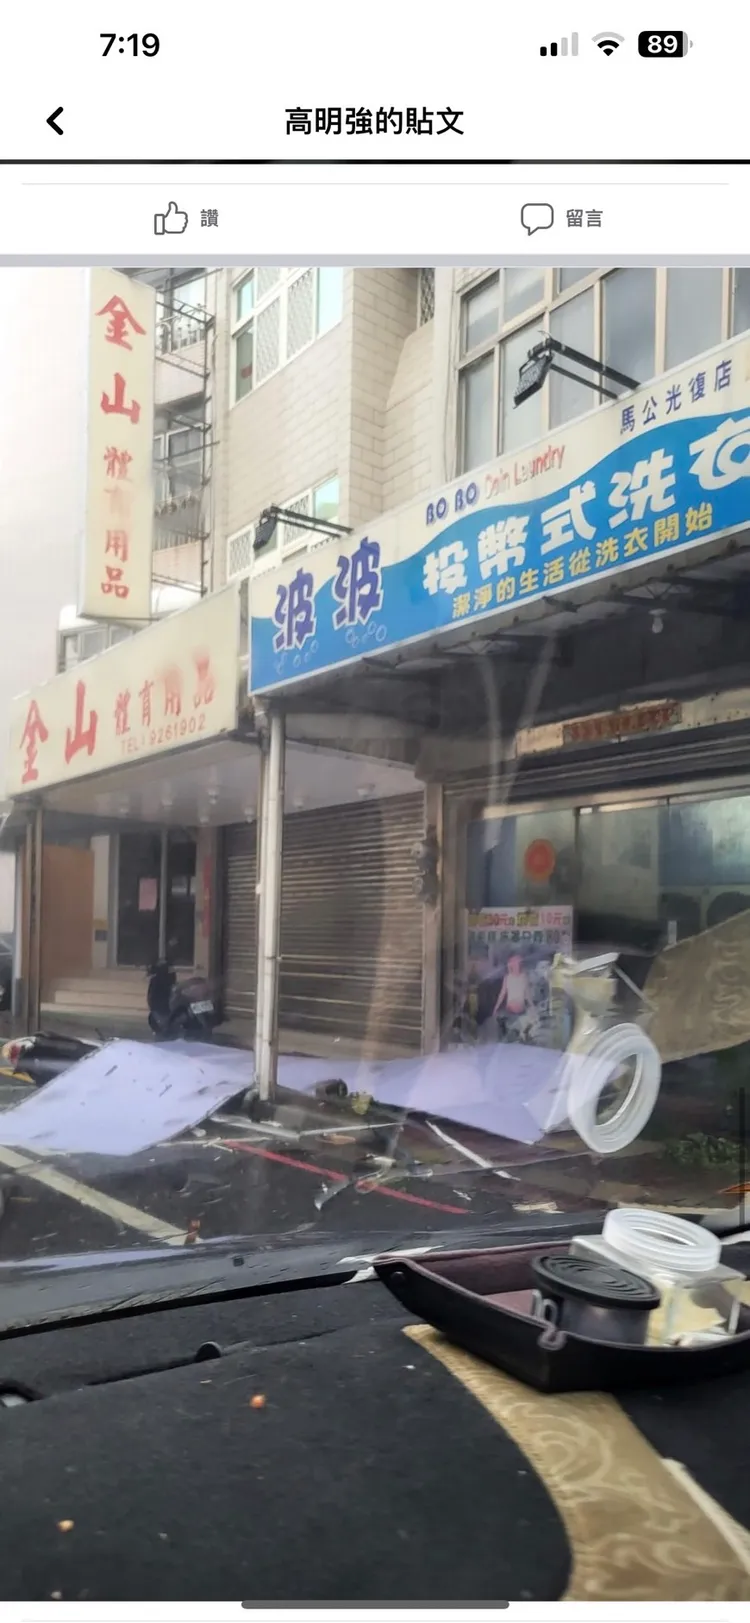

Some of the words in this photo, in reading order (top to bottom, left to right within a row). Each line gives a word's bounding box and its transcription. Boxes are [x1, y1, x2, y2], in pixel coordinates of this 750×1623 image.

[620, 359, 732, 435] 馬公光復店
[422, 416, 750, 595] 投幣式洗衣
[426, 503, 447, 525] BO
[455, 482, 477, 512] BO
[452, 502, 713, 618] 潔淨的生活從洗衣開始
[272, 536, 383, 652] 波波
